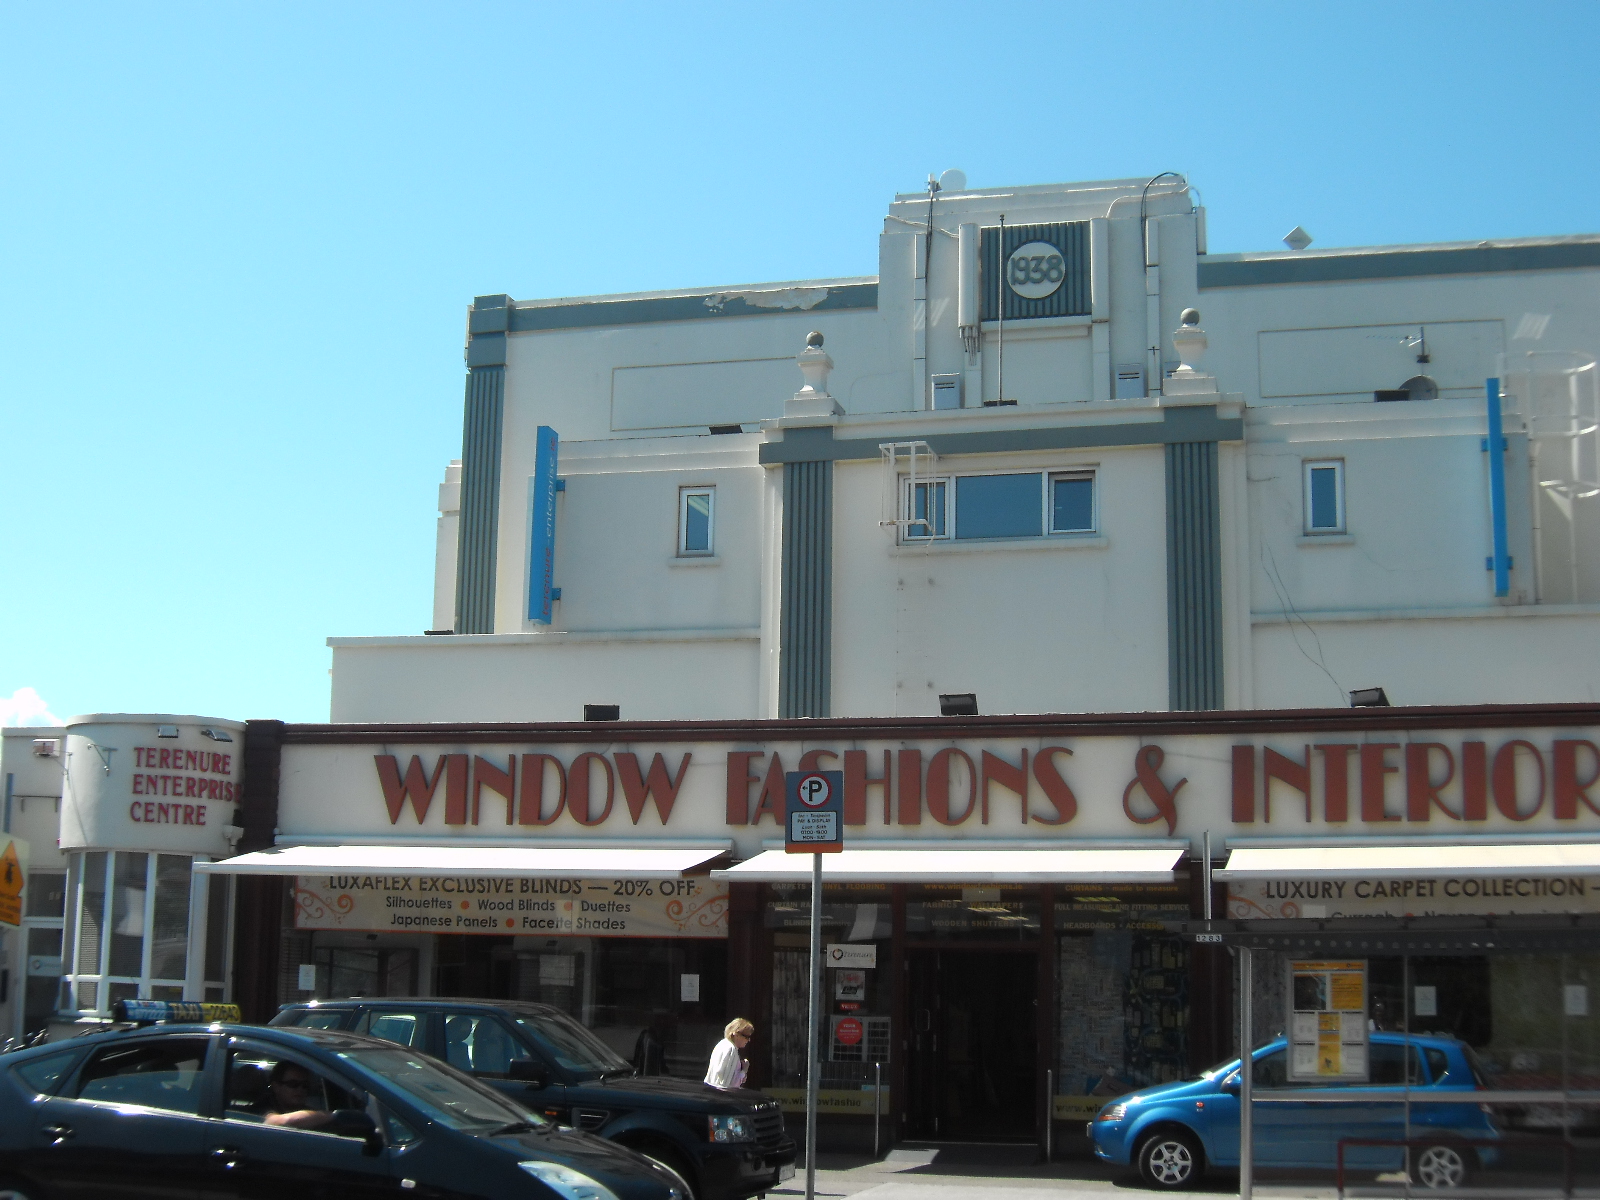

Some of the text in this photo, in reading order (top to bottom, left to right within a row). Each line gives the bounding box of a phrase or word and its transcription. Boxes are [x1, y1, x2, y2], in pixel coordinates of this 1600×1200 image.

[1010, 254, 1063, 285] 1938
[133, 746, 231, 775] TERENURE
[373, 751, 692, 826] WINDOW
[1122, 744, 1189, 836] &
[808, 780, 823, 802] P
[130, 801, 206, 825] CENTRE
[329, 876, 412, 891] LUXAFLEX
[419, 877, 514, 893] EXCLUSIVE
[520, 878, 582, 895] BLINDS
[613, 880, 653, 897] 20%
[658, 880, 696, 896] OFF
[1266, 878, 1585, 899] LUXURY CARPET COLLECTION
[386, 896, 631, 912] Silhouettes Wood Blinds Duettes
[391, 913, 452, 927] Japanese
[456, 916, 498, 928] Panels
[576, 917, 626, 930] Shades
[169, 1003, 199, 1021] TAXI
